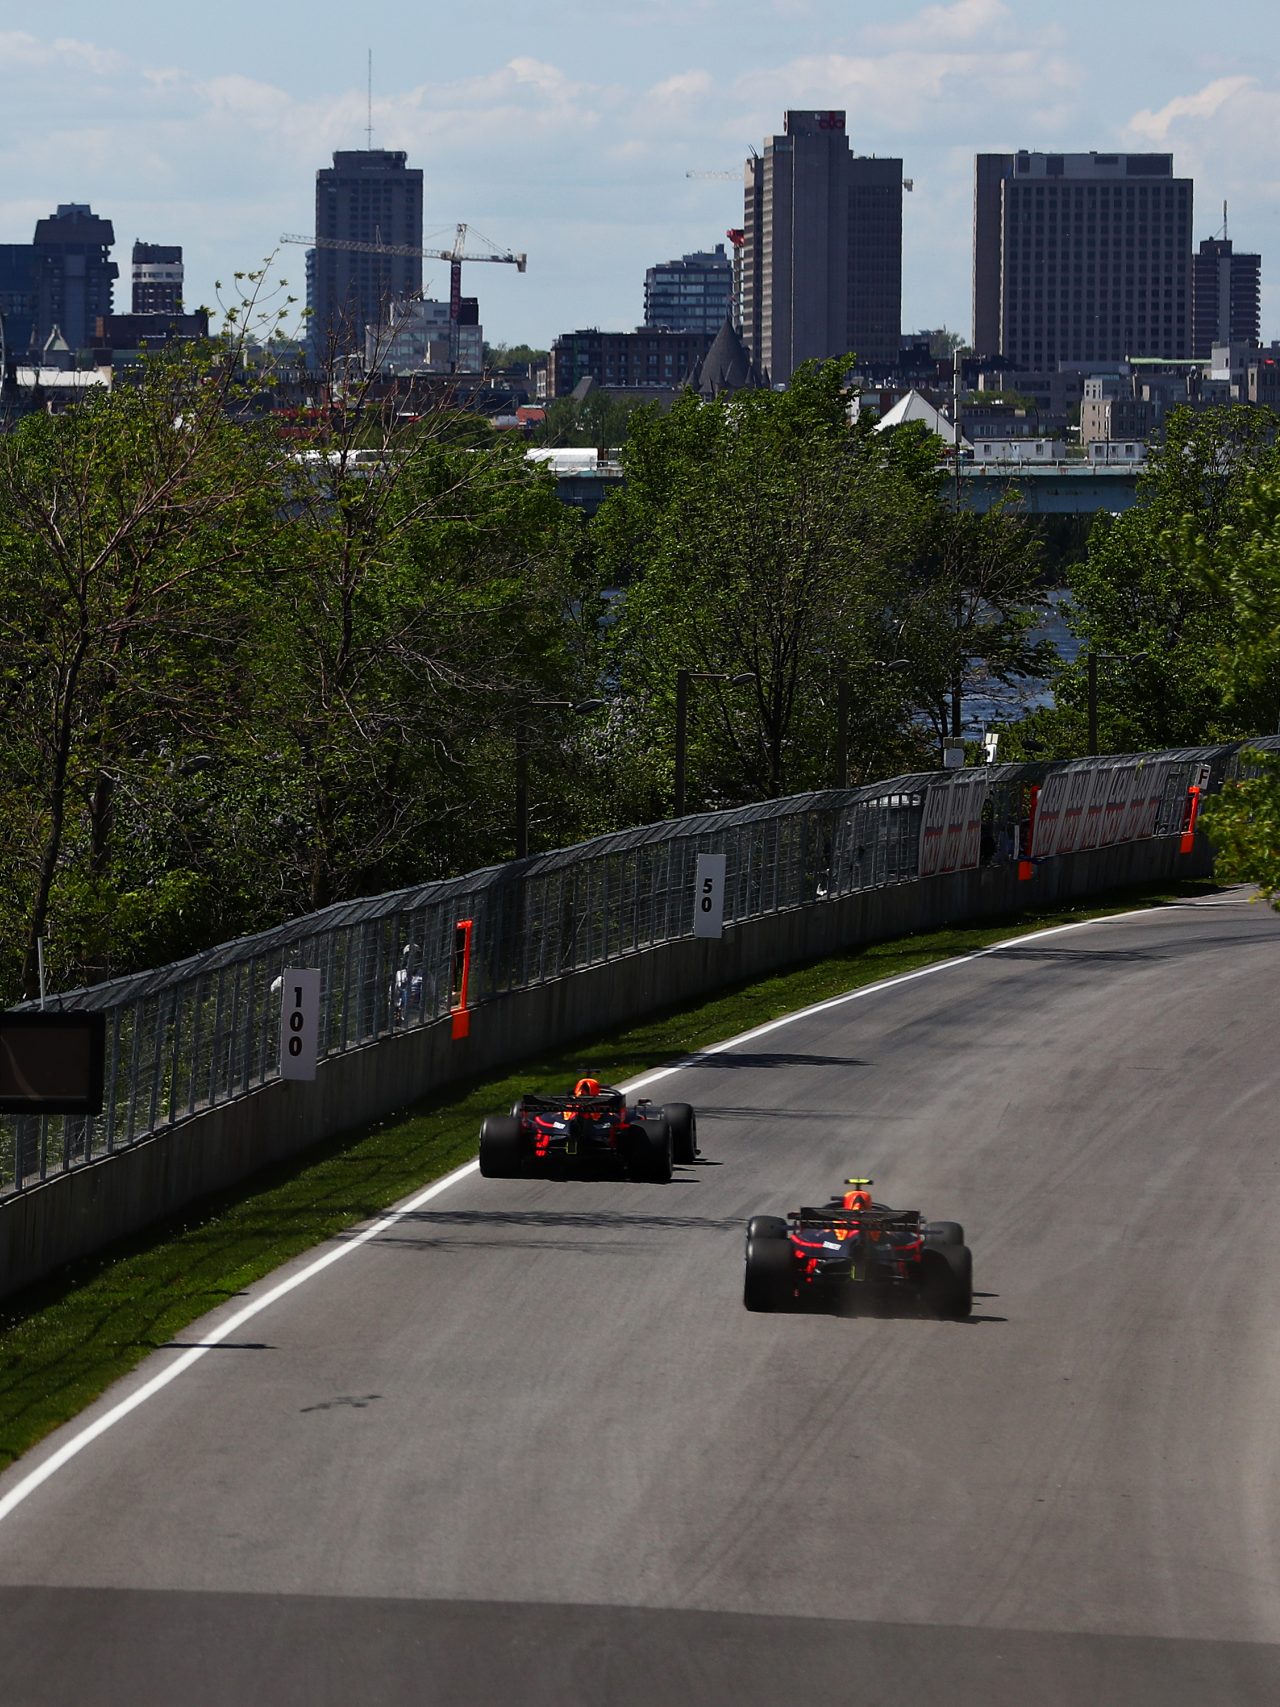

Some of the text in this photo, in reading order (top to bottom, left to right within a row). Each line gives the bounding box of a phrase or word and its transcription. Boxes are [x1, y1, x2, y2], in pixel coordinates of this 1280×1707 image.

[1198, 768, 1209, 785] F
[701, 878, 713, 913] 50
[288, 986, 304, 1057] 100
